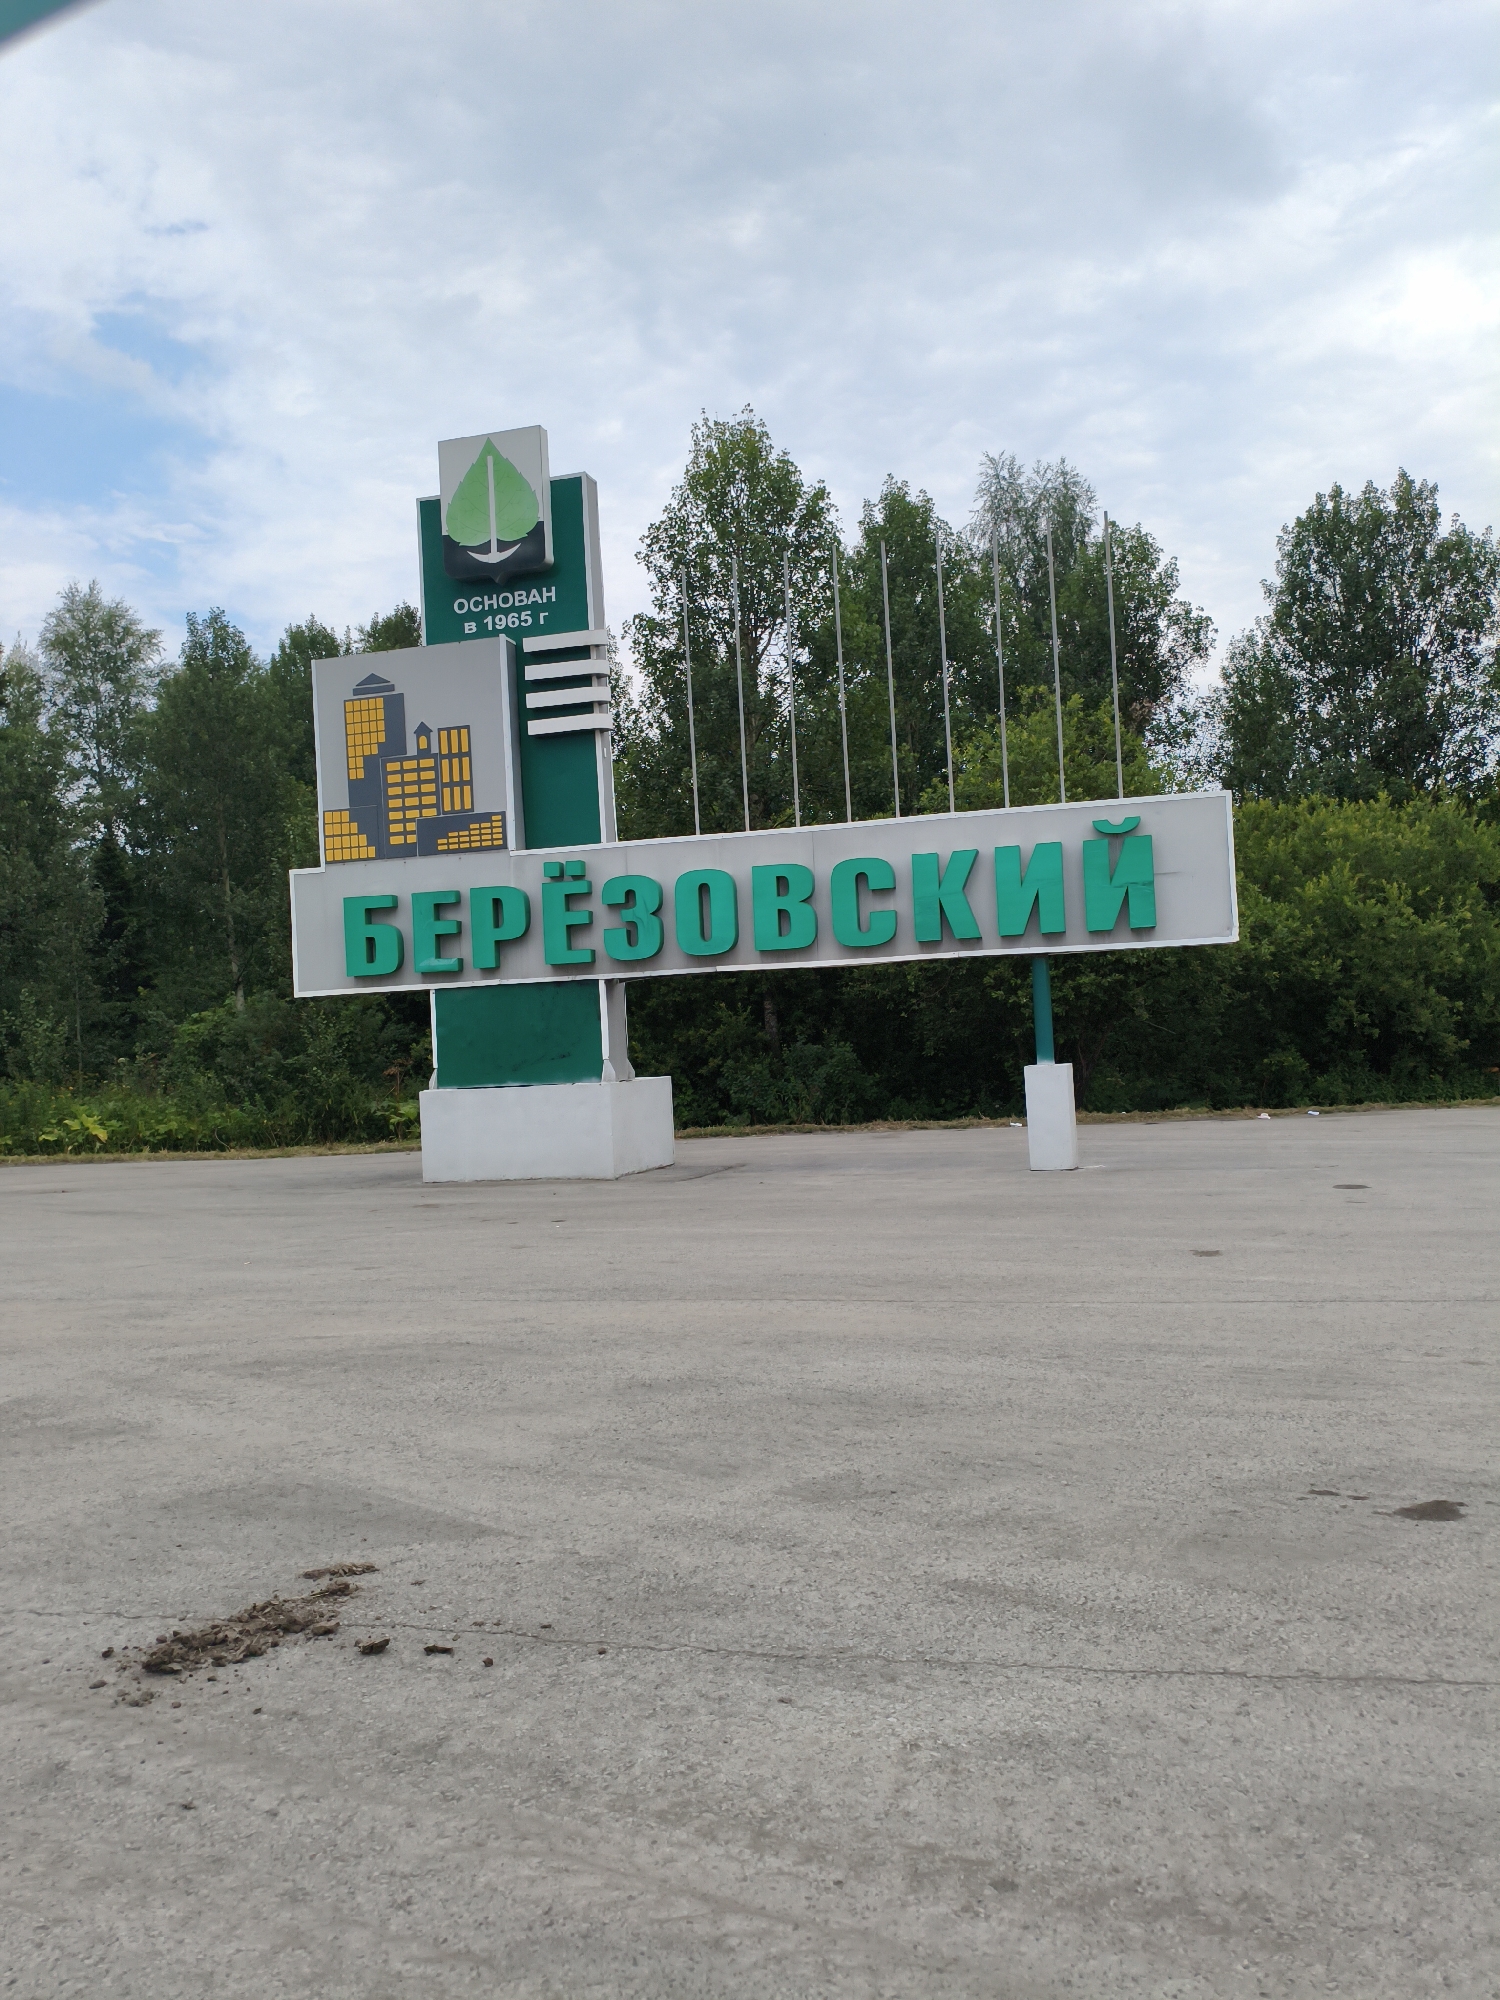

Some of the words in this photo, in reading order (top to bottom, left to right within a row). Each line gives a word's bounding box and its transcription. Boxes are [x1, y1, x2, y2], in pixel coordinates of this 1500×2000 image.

[453, 586, 556, 614] ОСНОВАН
[483, 610, 533, 631] 1965
[539, 612, 549, 625] г
[343, 816, 1157, 977] БЕРЁЗОВСКИЙ
